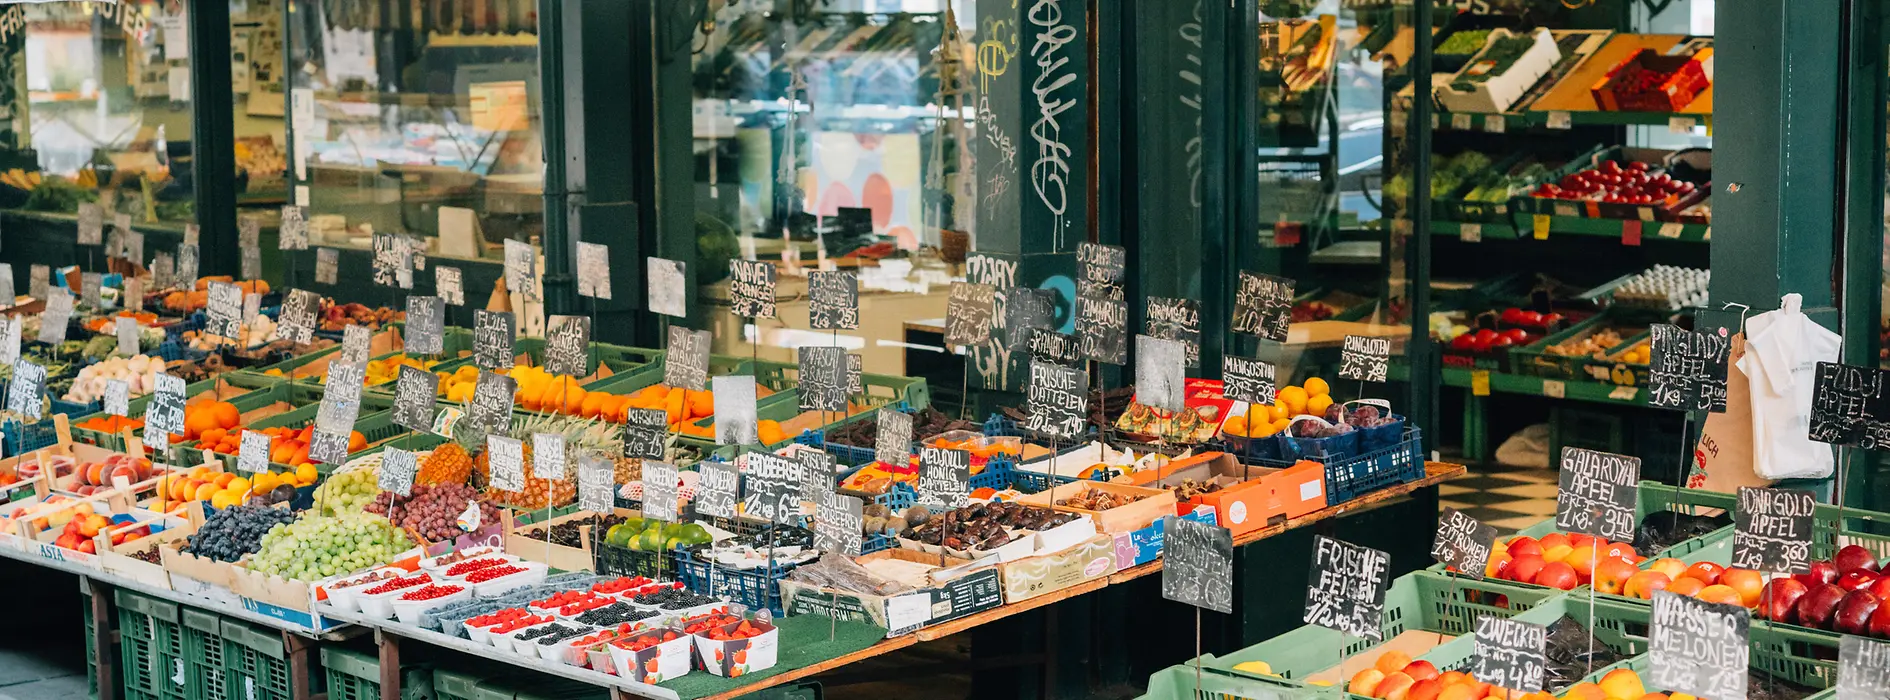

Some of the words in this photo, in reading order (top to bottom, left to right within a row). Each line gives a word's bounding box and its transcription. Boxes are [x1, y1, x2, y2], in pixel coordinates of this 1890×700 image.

[734, 260, 775, 288] NAVEL
[1031, 365, 1076, 390] FRISCHE
[1224, 357, 1275, 380] MANGOSTIN
[1030, 385, 1088, 413] DATTELEN
[628, 408, 667, 426] KIRSCHEN
[747, 451, 803, 482] ERDBEEREN
[798, 450, 831, 473] FRISCHE
[927, 465, 956, 482] HONIG
[801, 467, 833, 491] EIGEN
[920, 477, 967, 492] DATTELEN
[1451, 511, 1477, 535] BIO
[40, 544, 66, 561] ASTA
[1438, 522, 1490, 563] ZITRONEN
[1316, 538, 1386, 584] FRISCHE
[1320, 571, 1376, 604] FEIGEN
[1477, 616, 1547, 652] ZWECKEN
[1654, 624, 1749, 672] MELONEN
